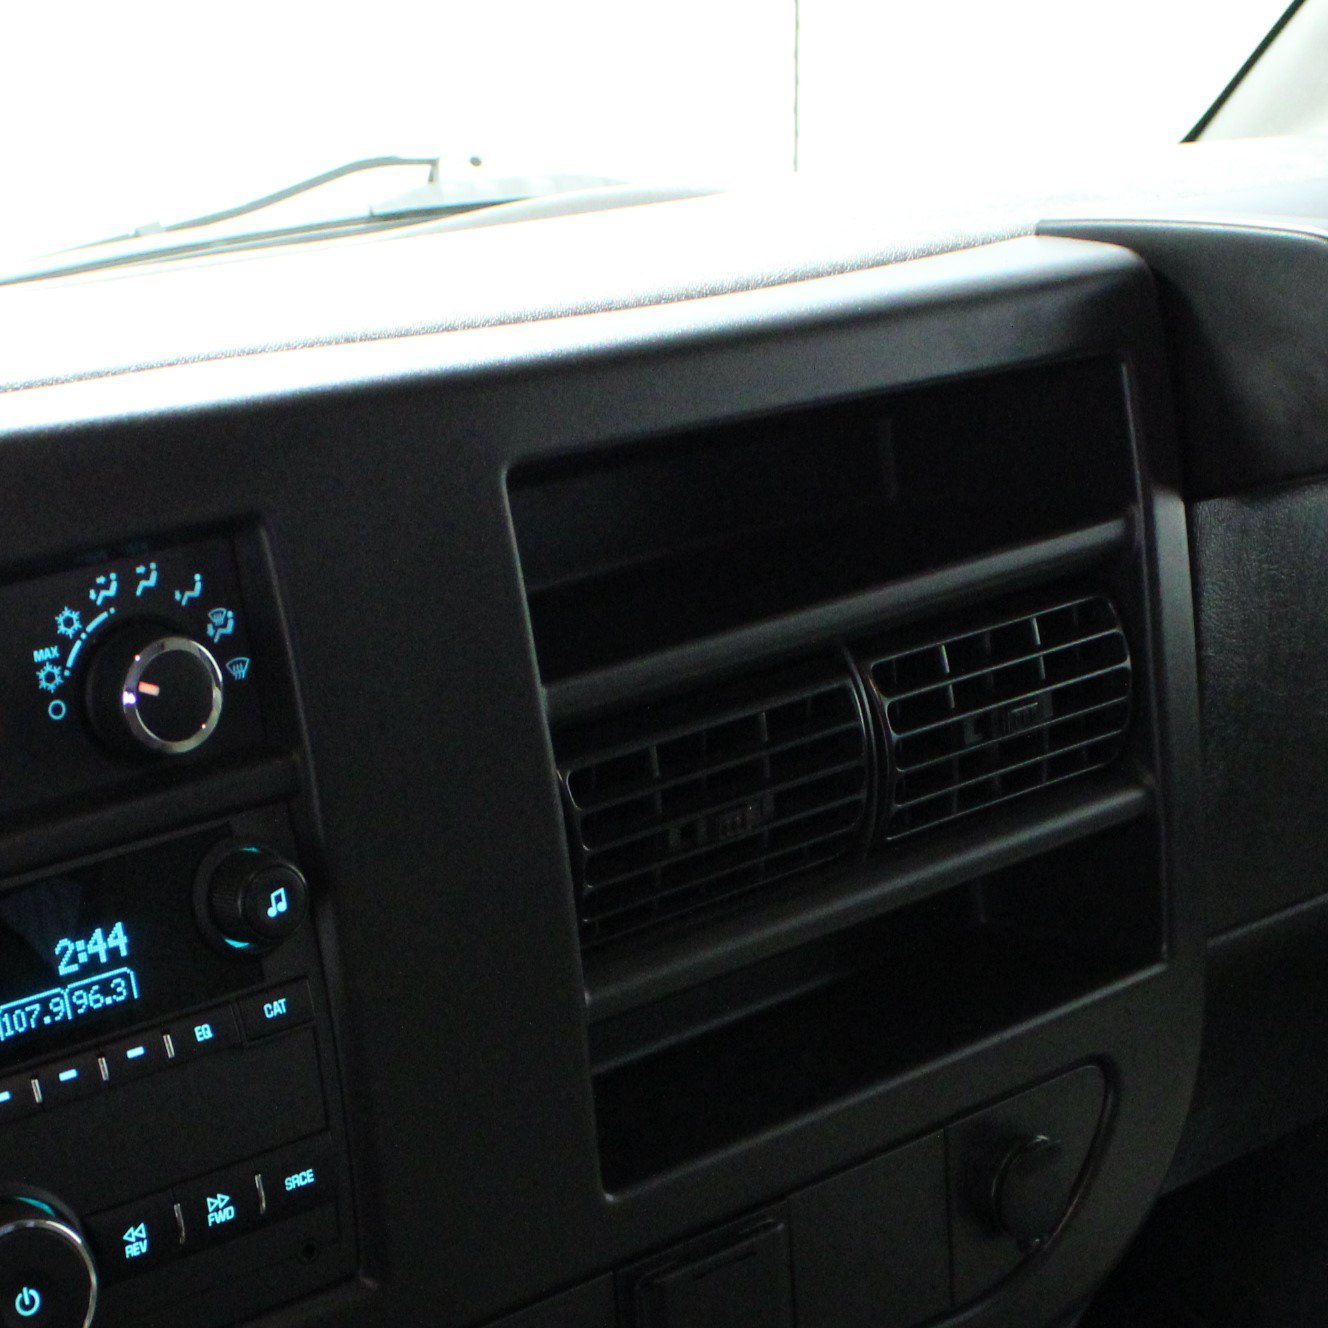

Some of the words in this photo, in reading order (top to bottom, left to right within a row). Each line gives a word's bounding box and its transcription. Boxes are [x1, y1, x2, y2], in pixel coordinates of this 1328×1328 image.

[33, 645, 60, 663] MAX
[55, 921, 129, 975] 2:44
[1, 997, 66, 1036] 107.9
[71, 977, 127, 1014] 96.3
[263, 998, 288, 1019] CAT
[194, 1024, 214, 1043] EQ
[284, 1168, 315, 1192] SRCE
[207, 1205, 235, 1227] FWD
[125, 1239, 148, 1259] REV
